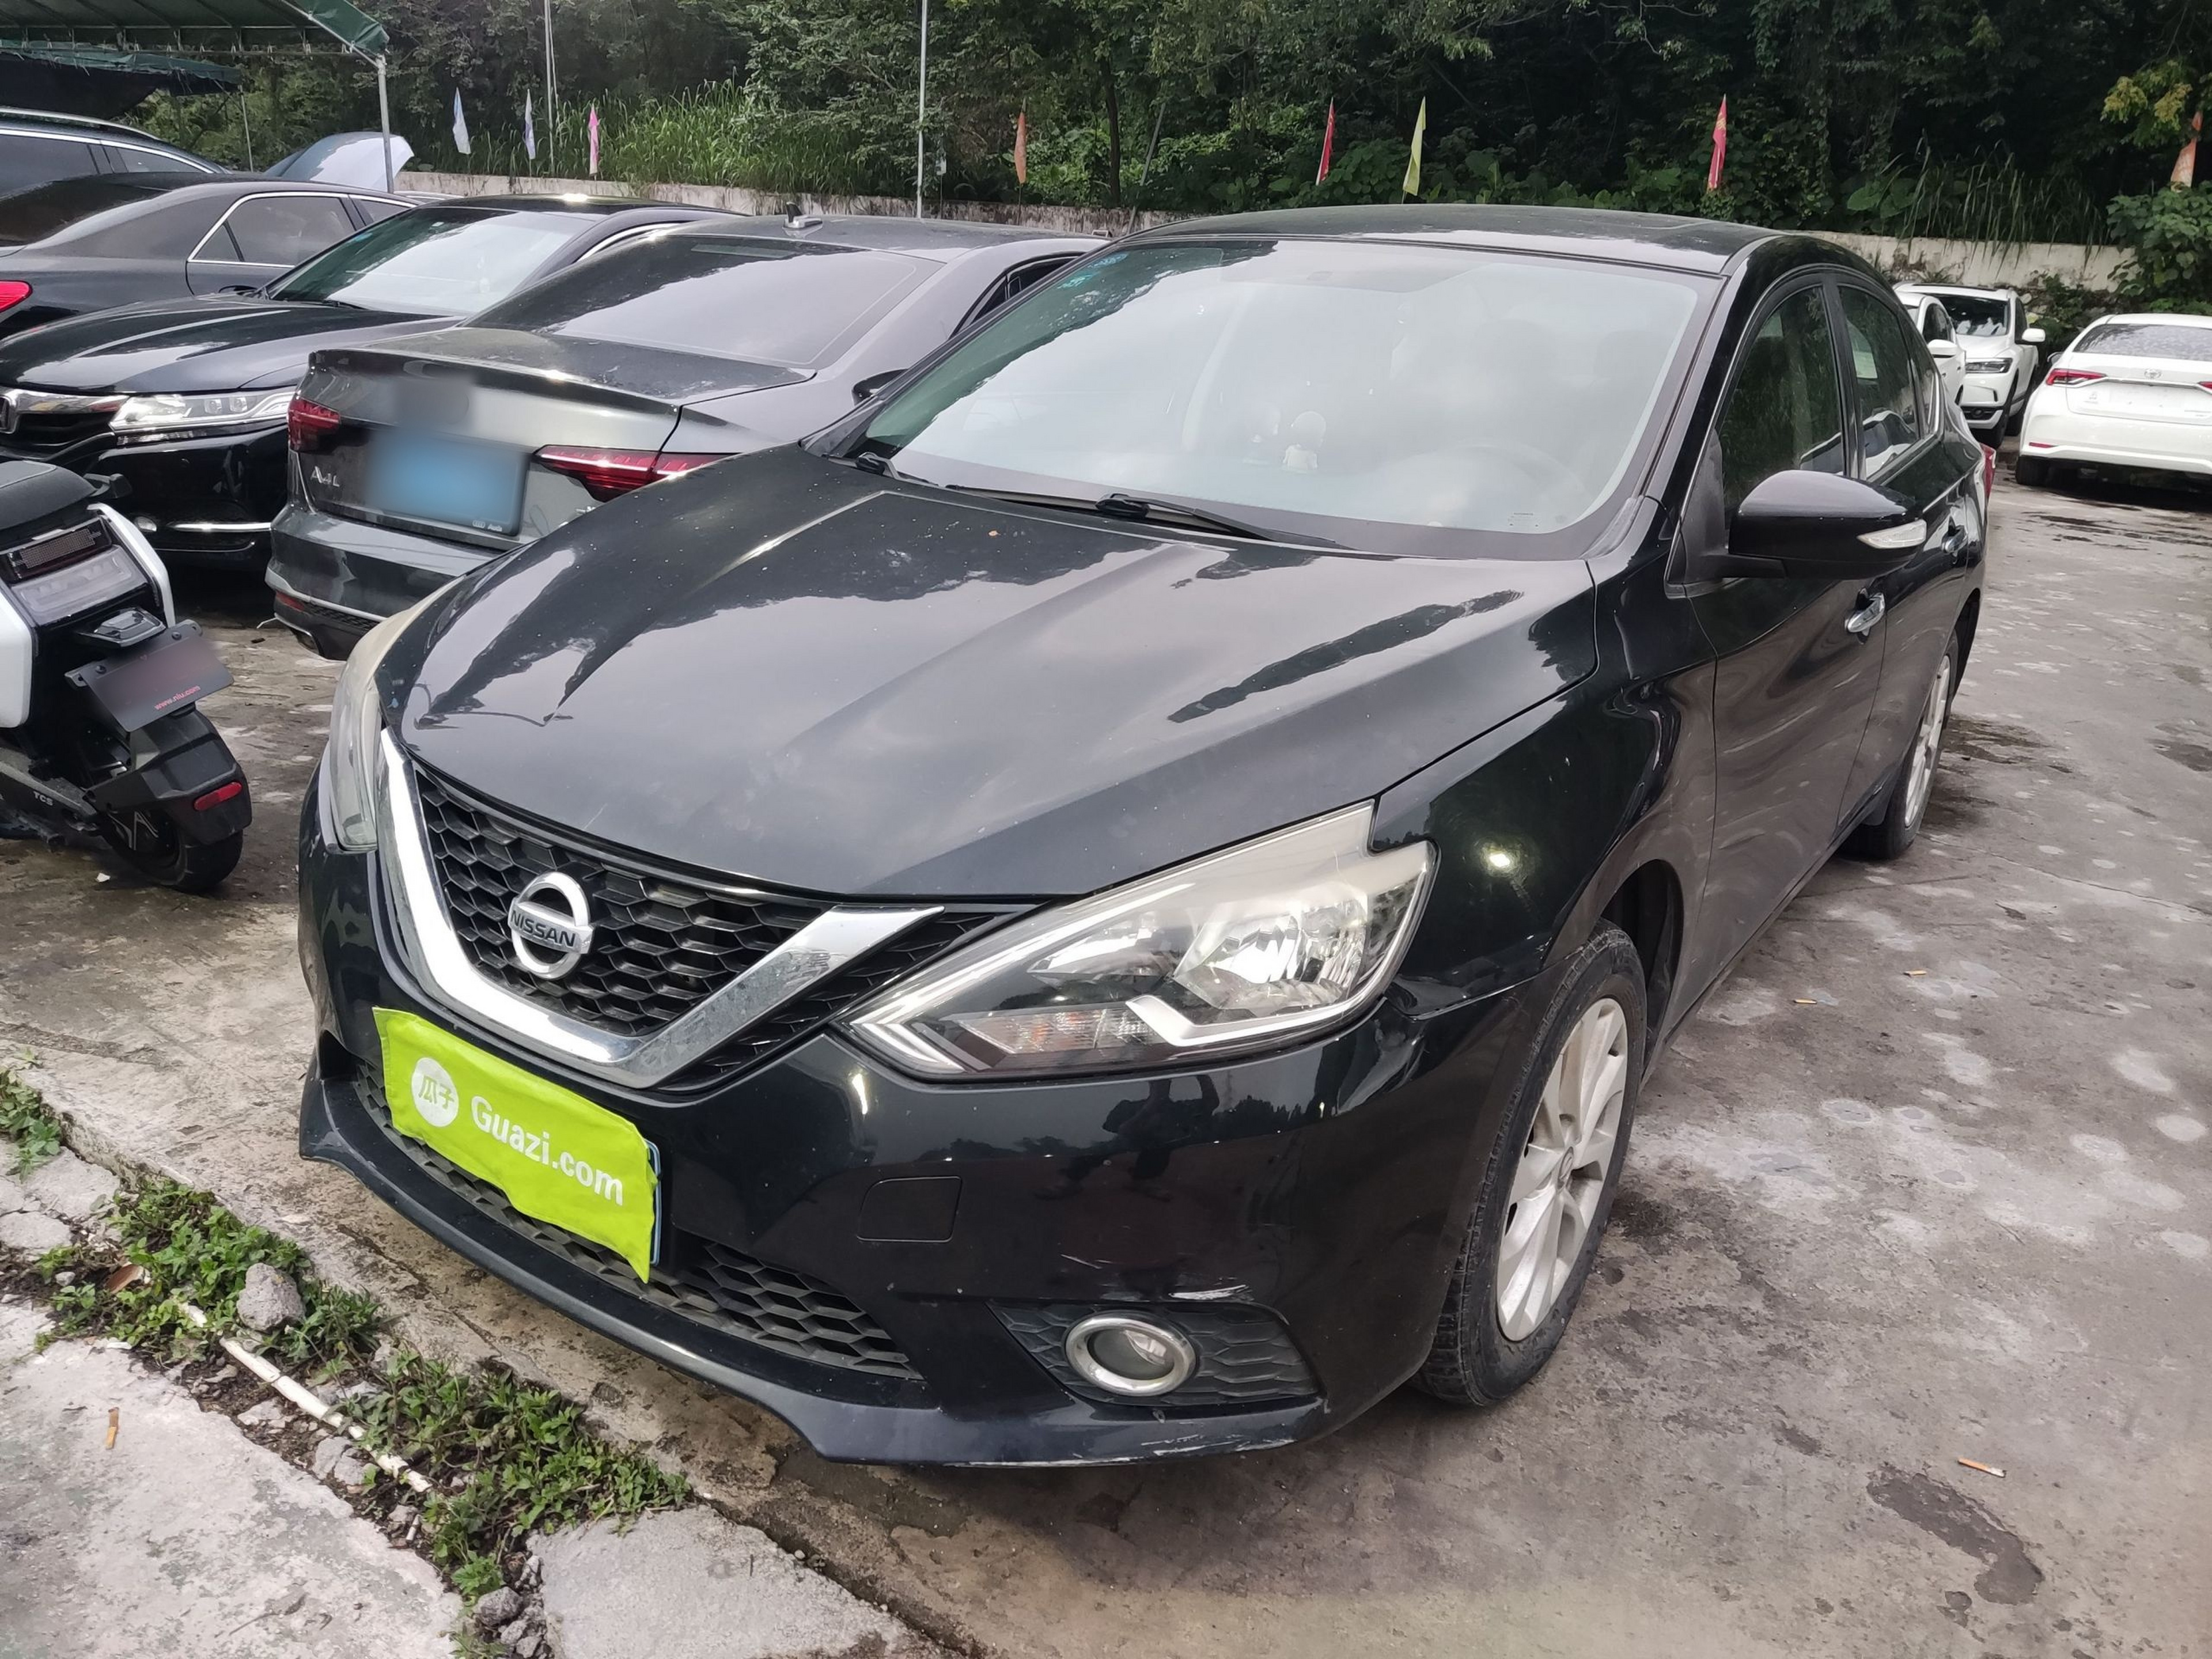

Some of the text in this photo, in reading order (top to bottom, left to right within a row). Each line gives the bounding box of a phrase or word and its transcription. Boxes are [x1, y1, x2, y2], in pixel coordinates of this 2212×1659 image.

[310, 465, 340, 487] A4L
[154, 685, 201, 710] www.niu.com
[33, 790, 54, 806] TCS
[511, 910, 575, 947] NISSAN
[419, 1076, 454, 1109] 瓜子
[471, 1096, 623, 1206] Guazi.com
